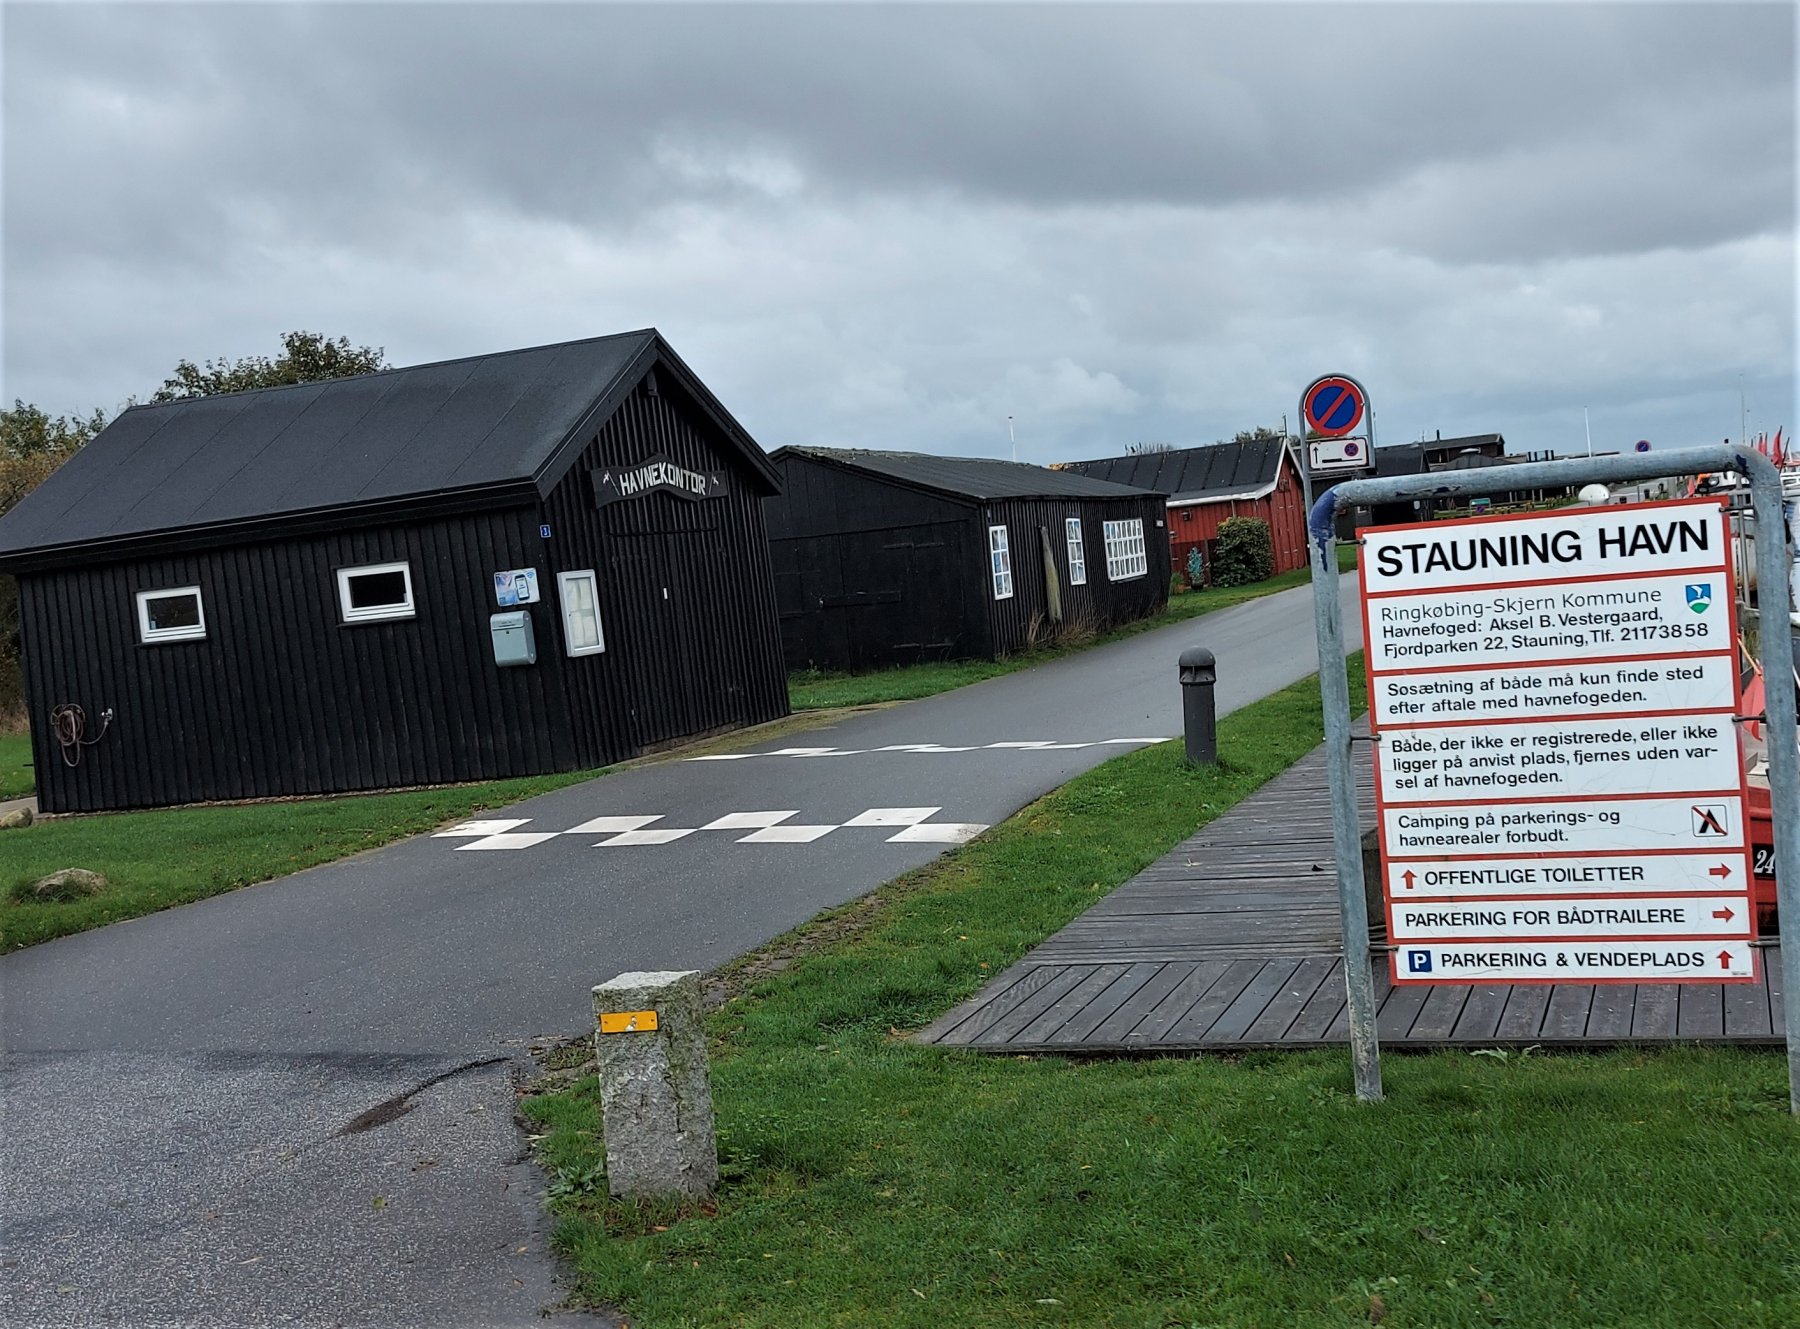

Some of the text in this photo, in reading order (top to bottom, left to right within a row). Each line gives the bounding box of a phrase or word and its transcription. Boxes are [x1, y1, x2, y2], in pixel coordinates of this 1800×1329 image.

[620, 462, 706, 496] HAVNEKONTOR
[1377, 519, 1708, 577] STAUNING HAVN
[1382, 590, 1661, 623] Ringkøbing-Skjern Kommune
[1383, 607, 1663, 638] Havnefoged: Aksel B. Vestergaard,
[1384, 623, 1708, 659] Fjordparken 22, Stauning, Tlf. 21173858
[1480, 678, 1495, 691] af
[1501, 676, 1542, 690] både
[1549, 673, 1573, 687] må
[1580, 672, 1610, 685] kun
[1617, 669, 1659, 683] finde
[1666, 666, 1703, 680] sted
[1389, 689, 1647, 714] efter aftale med havnefogeden.
[1392, 725, 1717, 753] Både, der ikke er registrerede, eller ikke
[1393, 746, 1718, 773] ligger på anvist plads, fjernes uden var-
[1395, 770, 1563, 789] sel af havnefogeden.
[1398, 810, 1620, 830] Camping på parkerings- og
[1399, 829, 1568, 846] havnearealer forbudt.
[1425, 866, 1644, 885] OFFENTLIGE TOILETTER
[1406, 906, 1685, 927] PARKERING FOR BÅDTRAILERE
[1413, 952, 1704, 969] P PARKERING & VENDEPLADS
